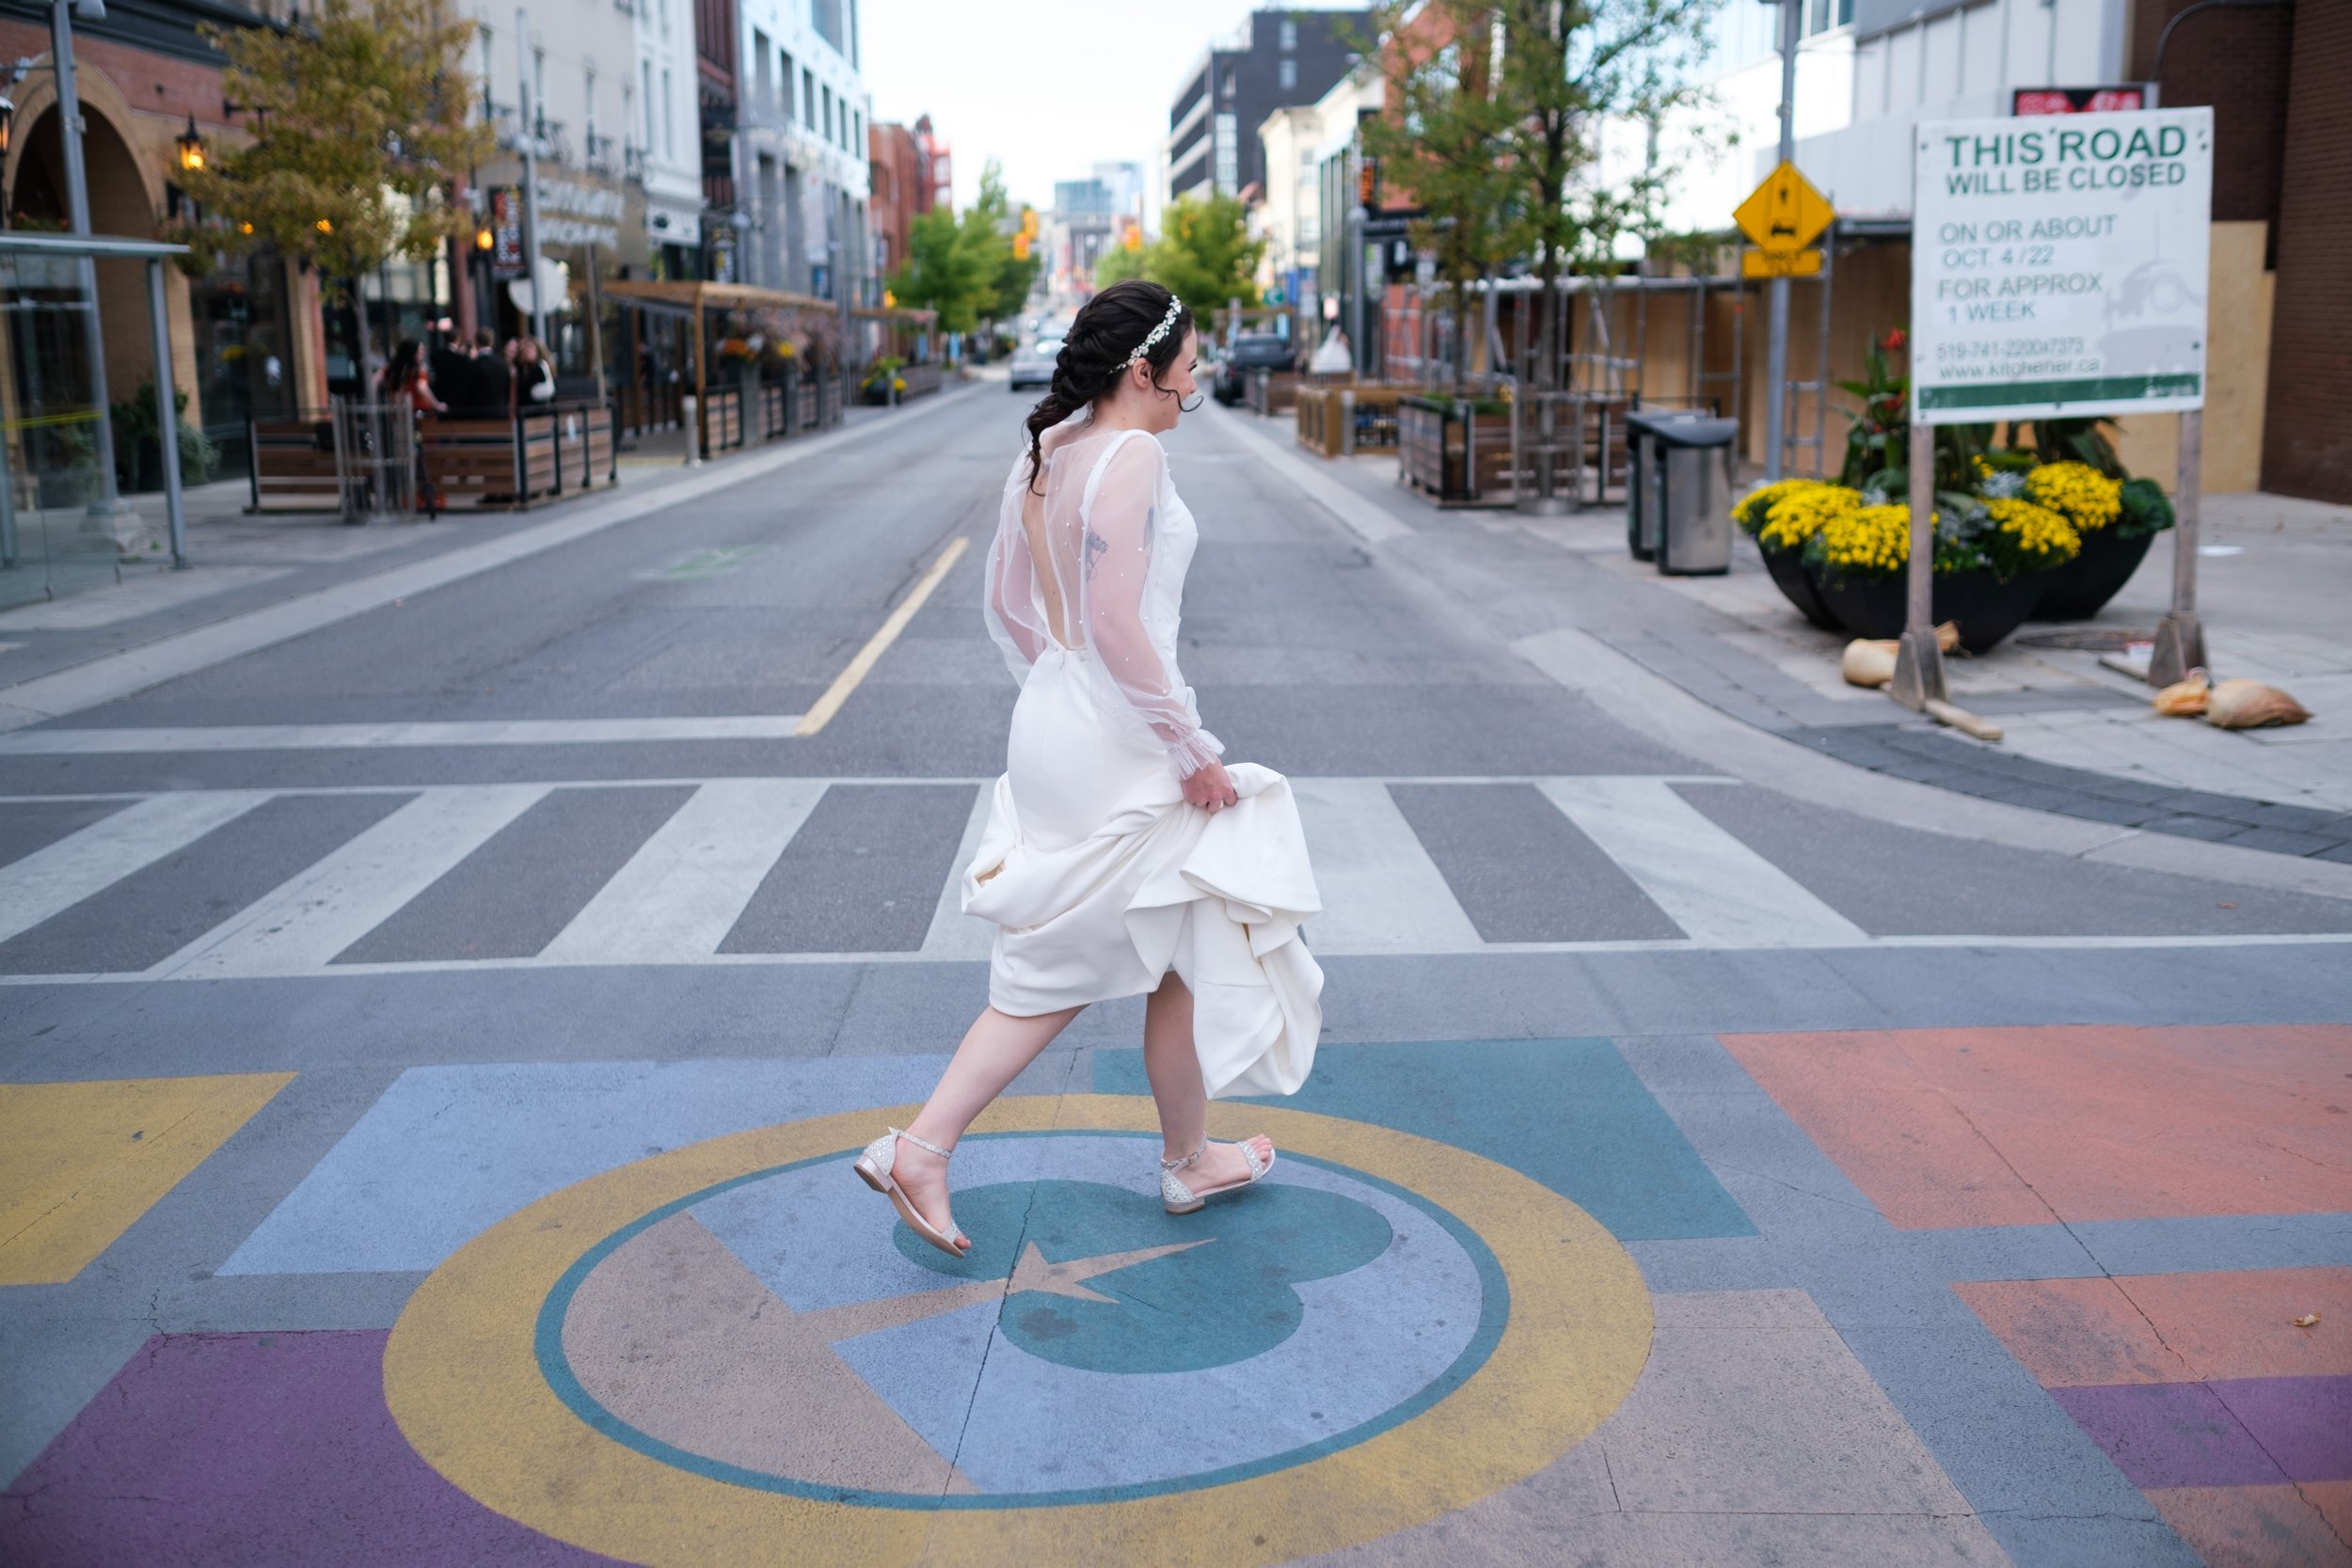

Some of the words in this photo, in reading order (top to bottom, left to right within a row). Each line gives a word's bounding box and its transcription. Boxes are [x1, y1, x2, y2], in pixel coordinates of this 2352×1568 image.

[1945, 132, 2044, 167] THIS
[2058, 125, 2187, 162] ROAD
[1946, 171, 2015, 195] WILL
[2023, 167, 2061, 192] BE
[2069, 162, 2186, 189] CLOSED
[1939, 222, 1978, 245] ON
[1985, 219, 2024, 242] OR
[2029, 214, 2117, 240] ABOUT
[1939, 277, 1991, 301] FOR
[1998, 271, 2104, 298] APPROX
[1948, 305, 1958, 322] 1
[1967, 299, 2036, 322] WEEK
